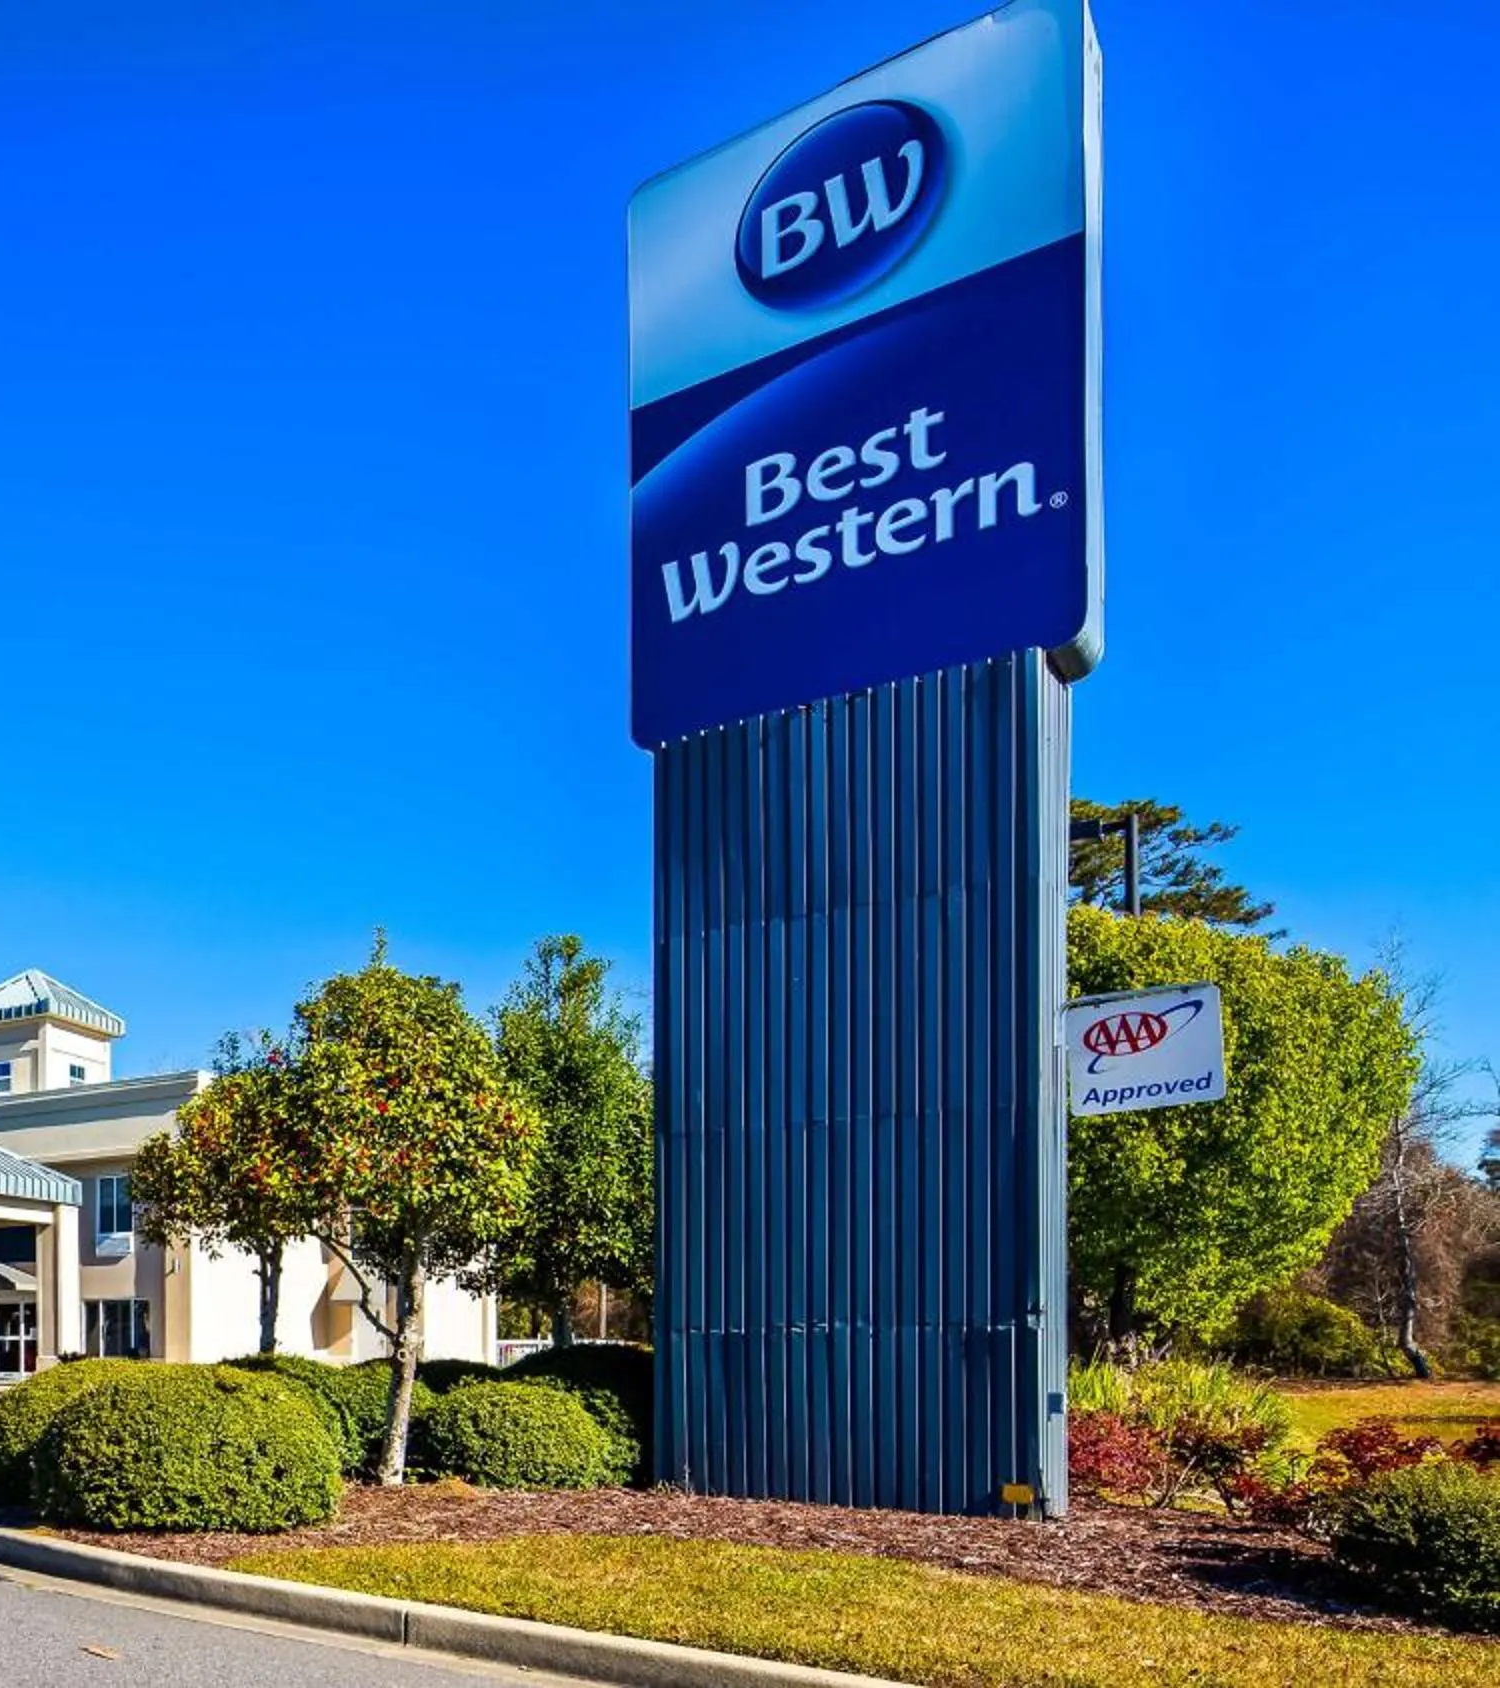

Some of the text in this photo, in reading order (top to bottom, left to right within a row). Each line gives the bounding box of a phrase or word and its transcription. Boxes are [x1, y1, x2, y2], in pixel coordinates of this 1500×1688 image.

[761, 139, 924, 281] BW
[745, 407, 947, 527] Best
[1091, 1013, 1161, 1055] AAA
[1082, 1071, 1213, 1106] Approved
